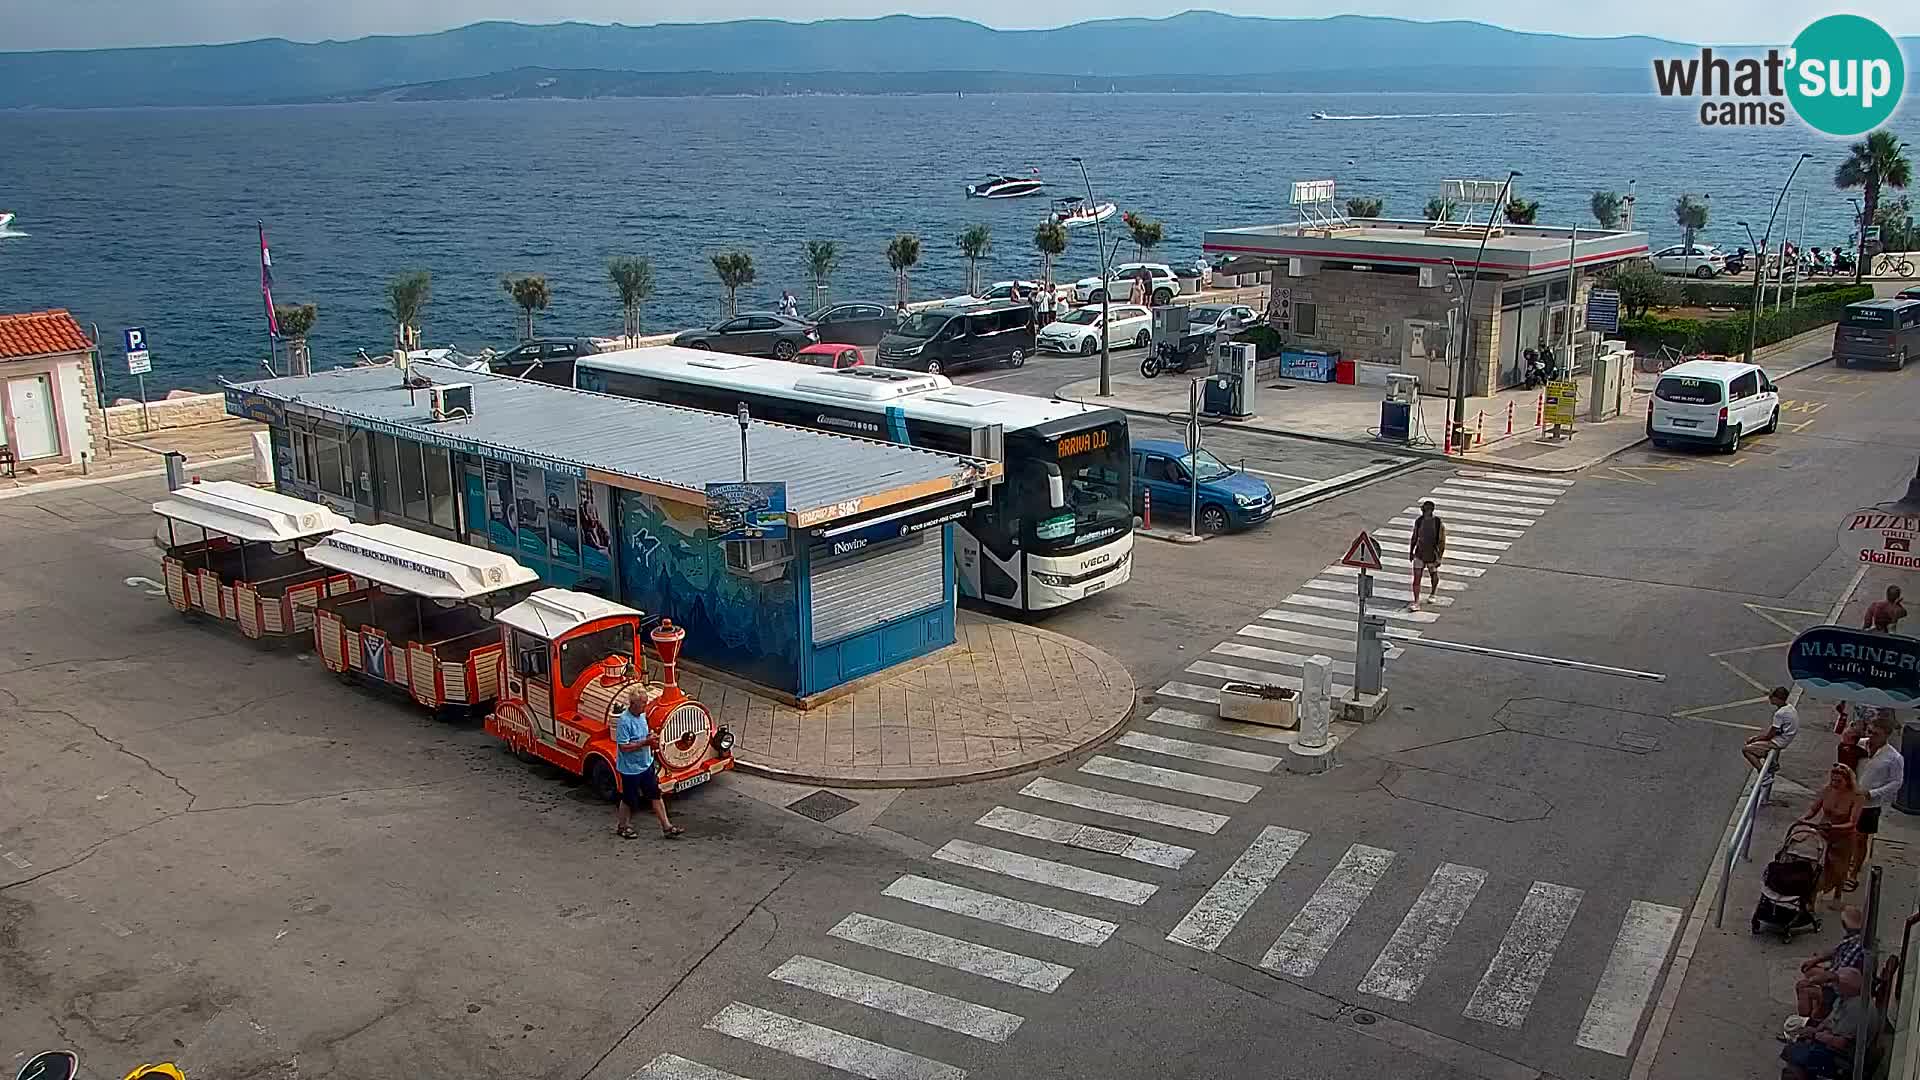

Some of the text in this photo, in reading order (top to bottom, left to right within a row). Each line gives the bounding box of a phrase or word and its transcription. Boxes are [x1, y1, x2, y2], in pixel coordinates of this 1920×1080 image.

[129, 330, 142, 349] P
[396, 427, 435, 445] AUTOBUSNA
[436, 437, 467, 451] POSTAJA
[1058, 430, 1109, 458] ARRIVA D.D.
[478, 446, 582, 477] BUS STATION TICKET OFFICE
[1848, 515, 1920, 532] PIZZE
[834, 538, 868, 556] iNovine
[328, 538, 339, 549] BOL
[339, 541, 359, 554] CENTER
[361, 548, 380, 560] BEACH
[413, 561, 424, 573] BOL
[424, 565, 446, 579] CENTER
[1080, 553, 1110, 570] IVECO
[1800, 641, 1920, 671] MARINER
[1828, 662, 1897, 679] caffe bar
